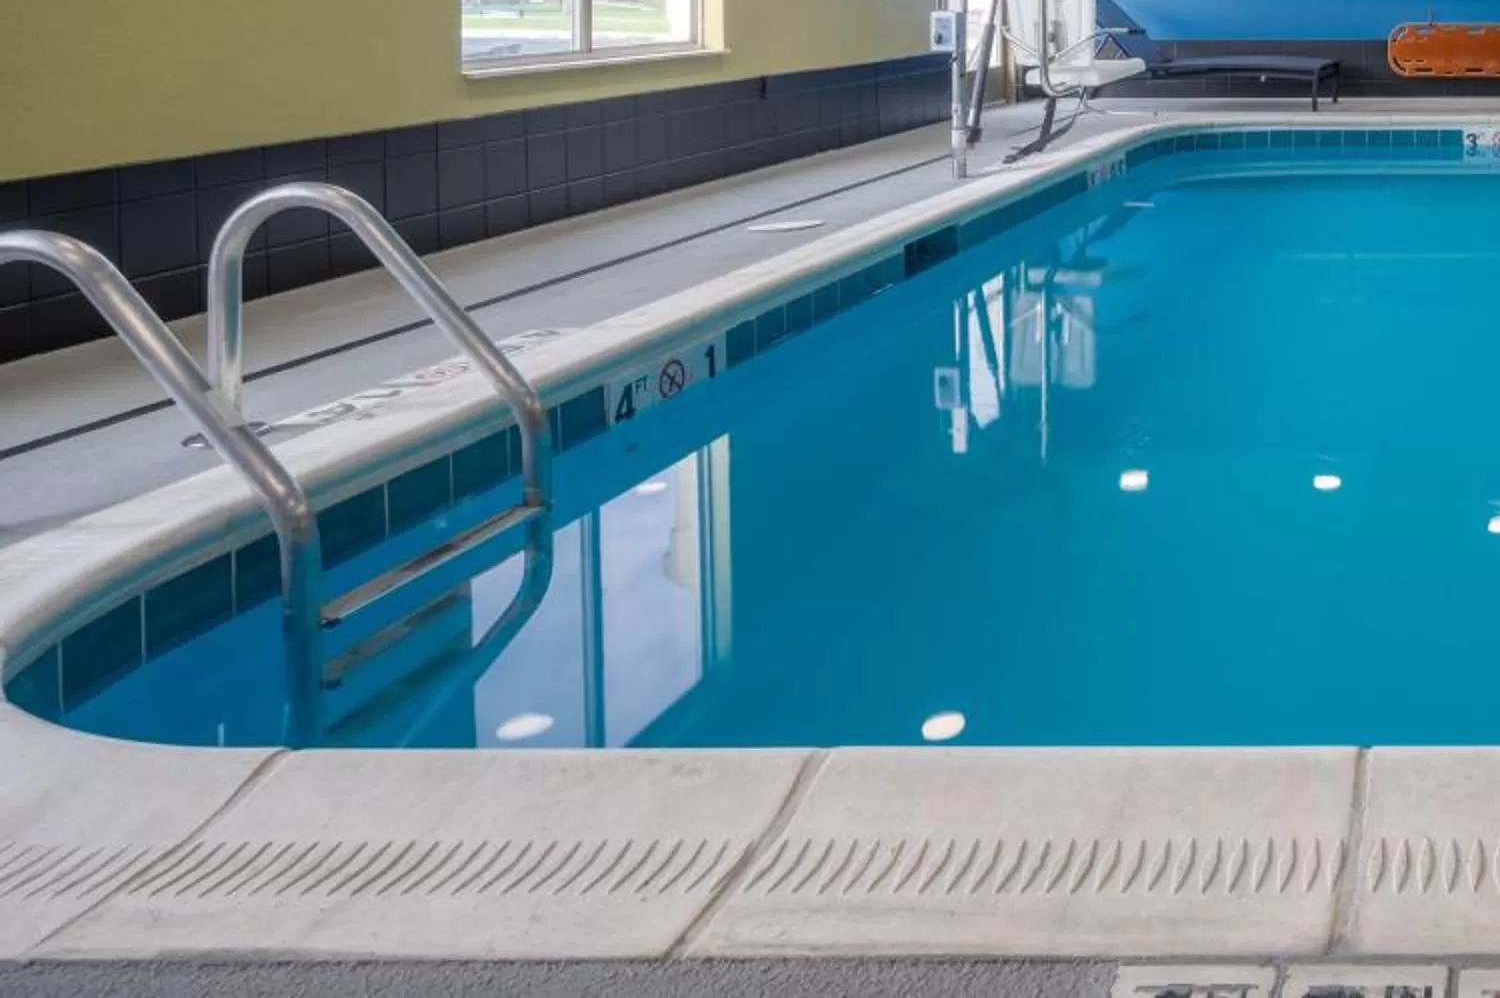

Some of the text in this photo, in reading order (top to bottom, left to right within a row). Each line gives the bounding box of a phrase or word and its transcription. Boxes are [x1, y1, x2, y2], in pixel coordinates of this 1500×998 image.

[615, 345, 715, 423] 4 FT 1
